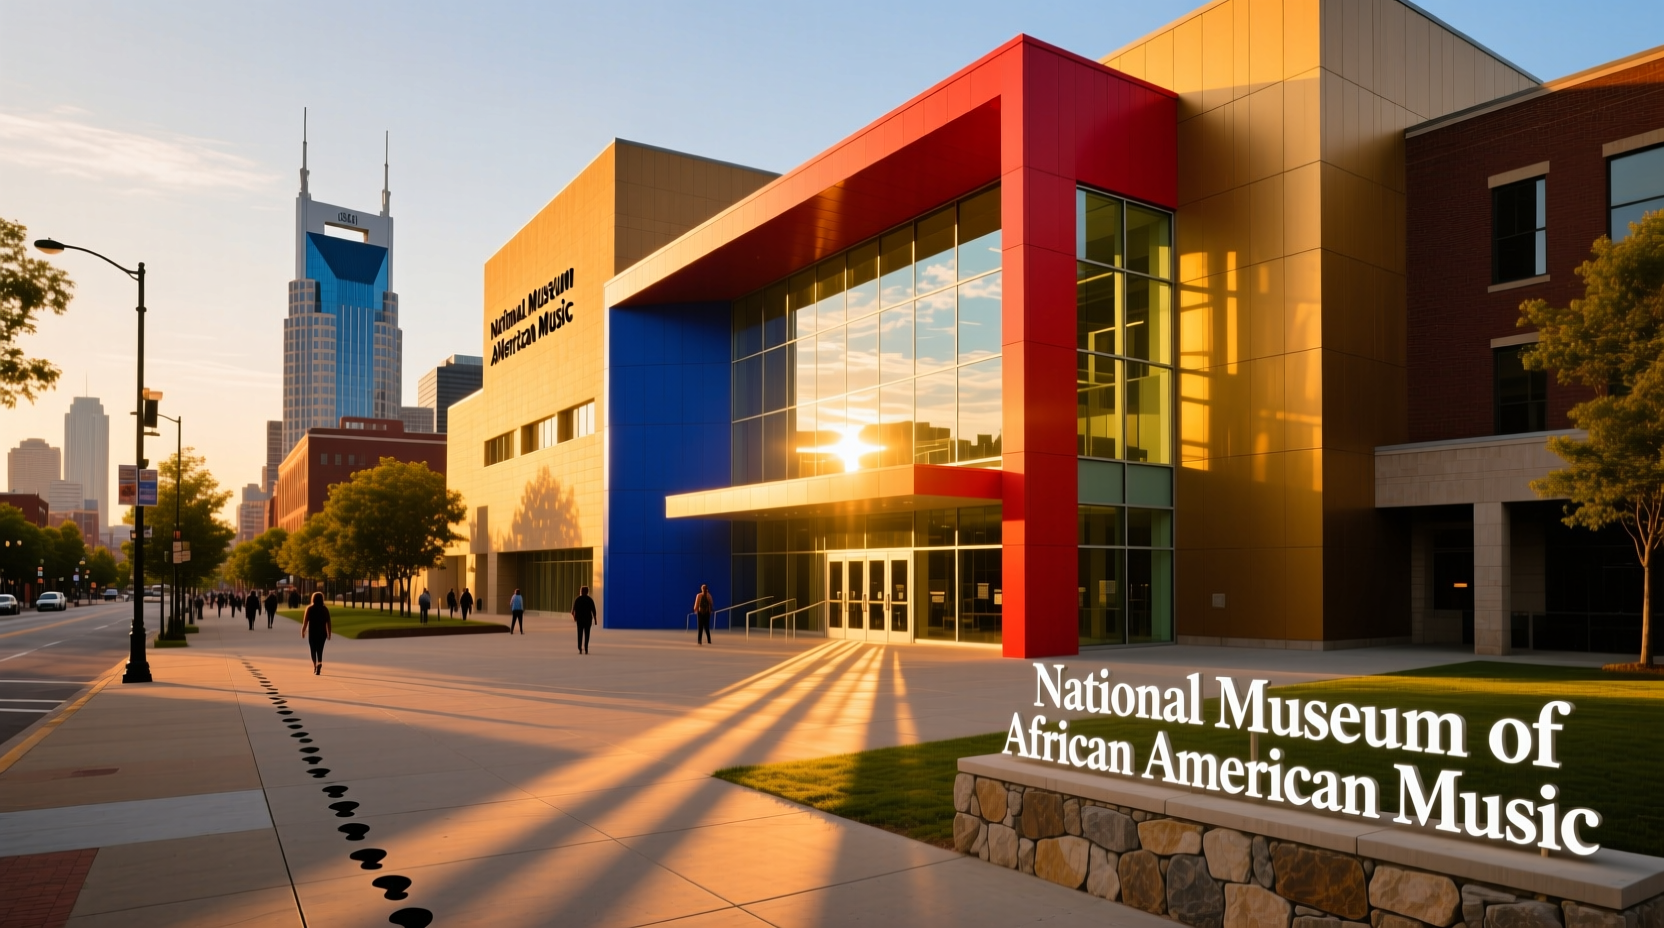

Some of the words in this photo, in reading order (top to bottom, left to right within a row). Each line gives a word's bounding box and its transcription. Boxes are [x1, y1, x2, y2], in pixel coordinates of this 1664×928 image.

[1033, 662, 1204, 725] National
[1215, 676, 1469, 758] Museum
[1488, 700, 1573, 768] of
[1001, 712, 1134, 776] African
[1141, 731, 1380, 819] American
[1393, 763, 1601, 856] Music
